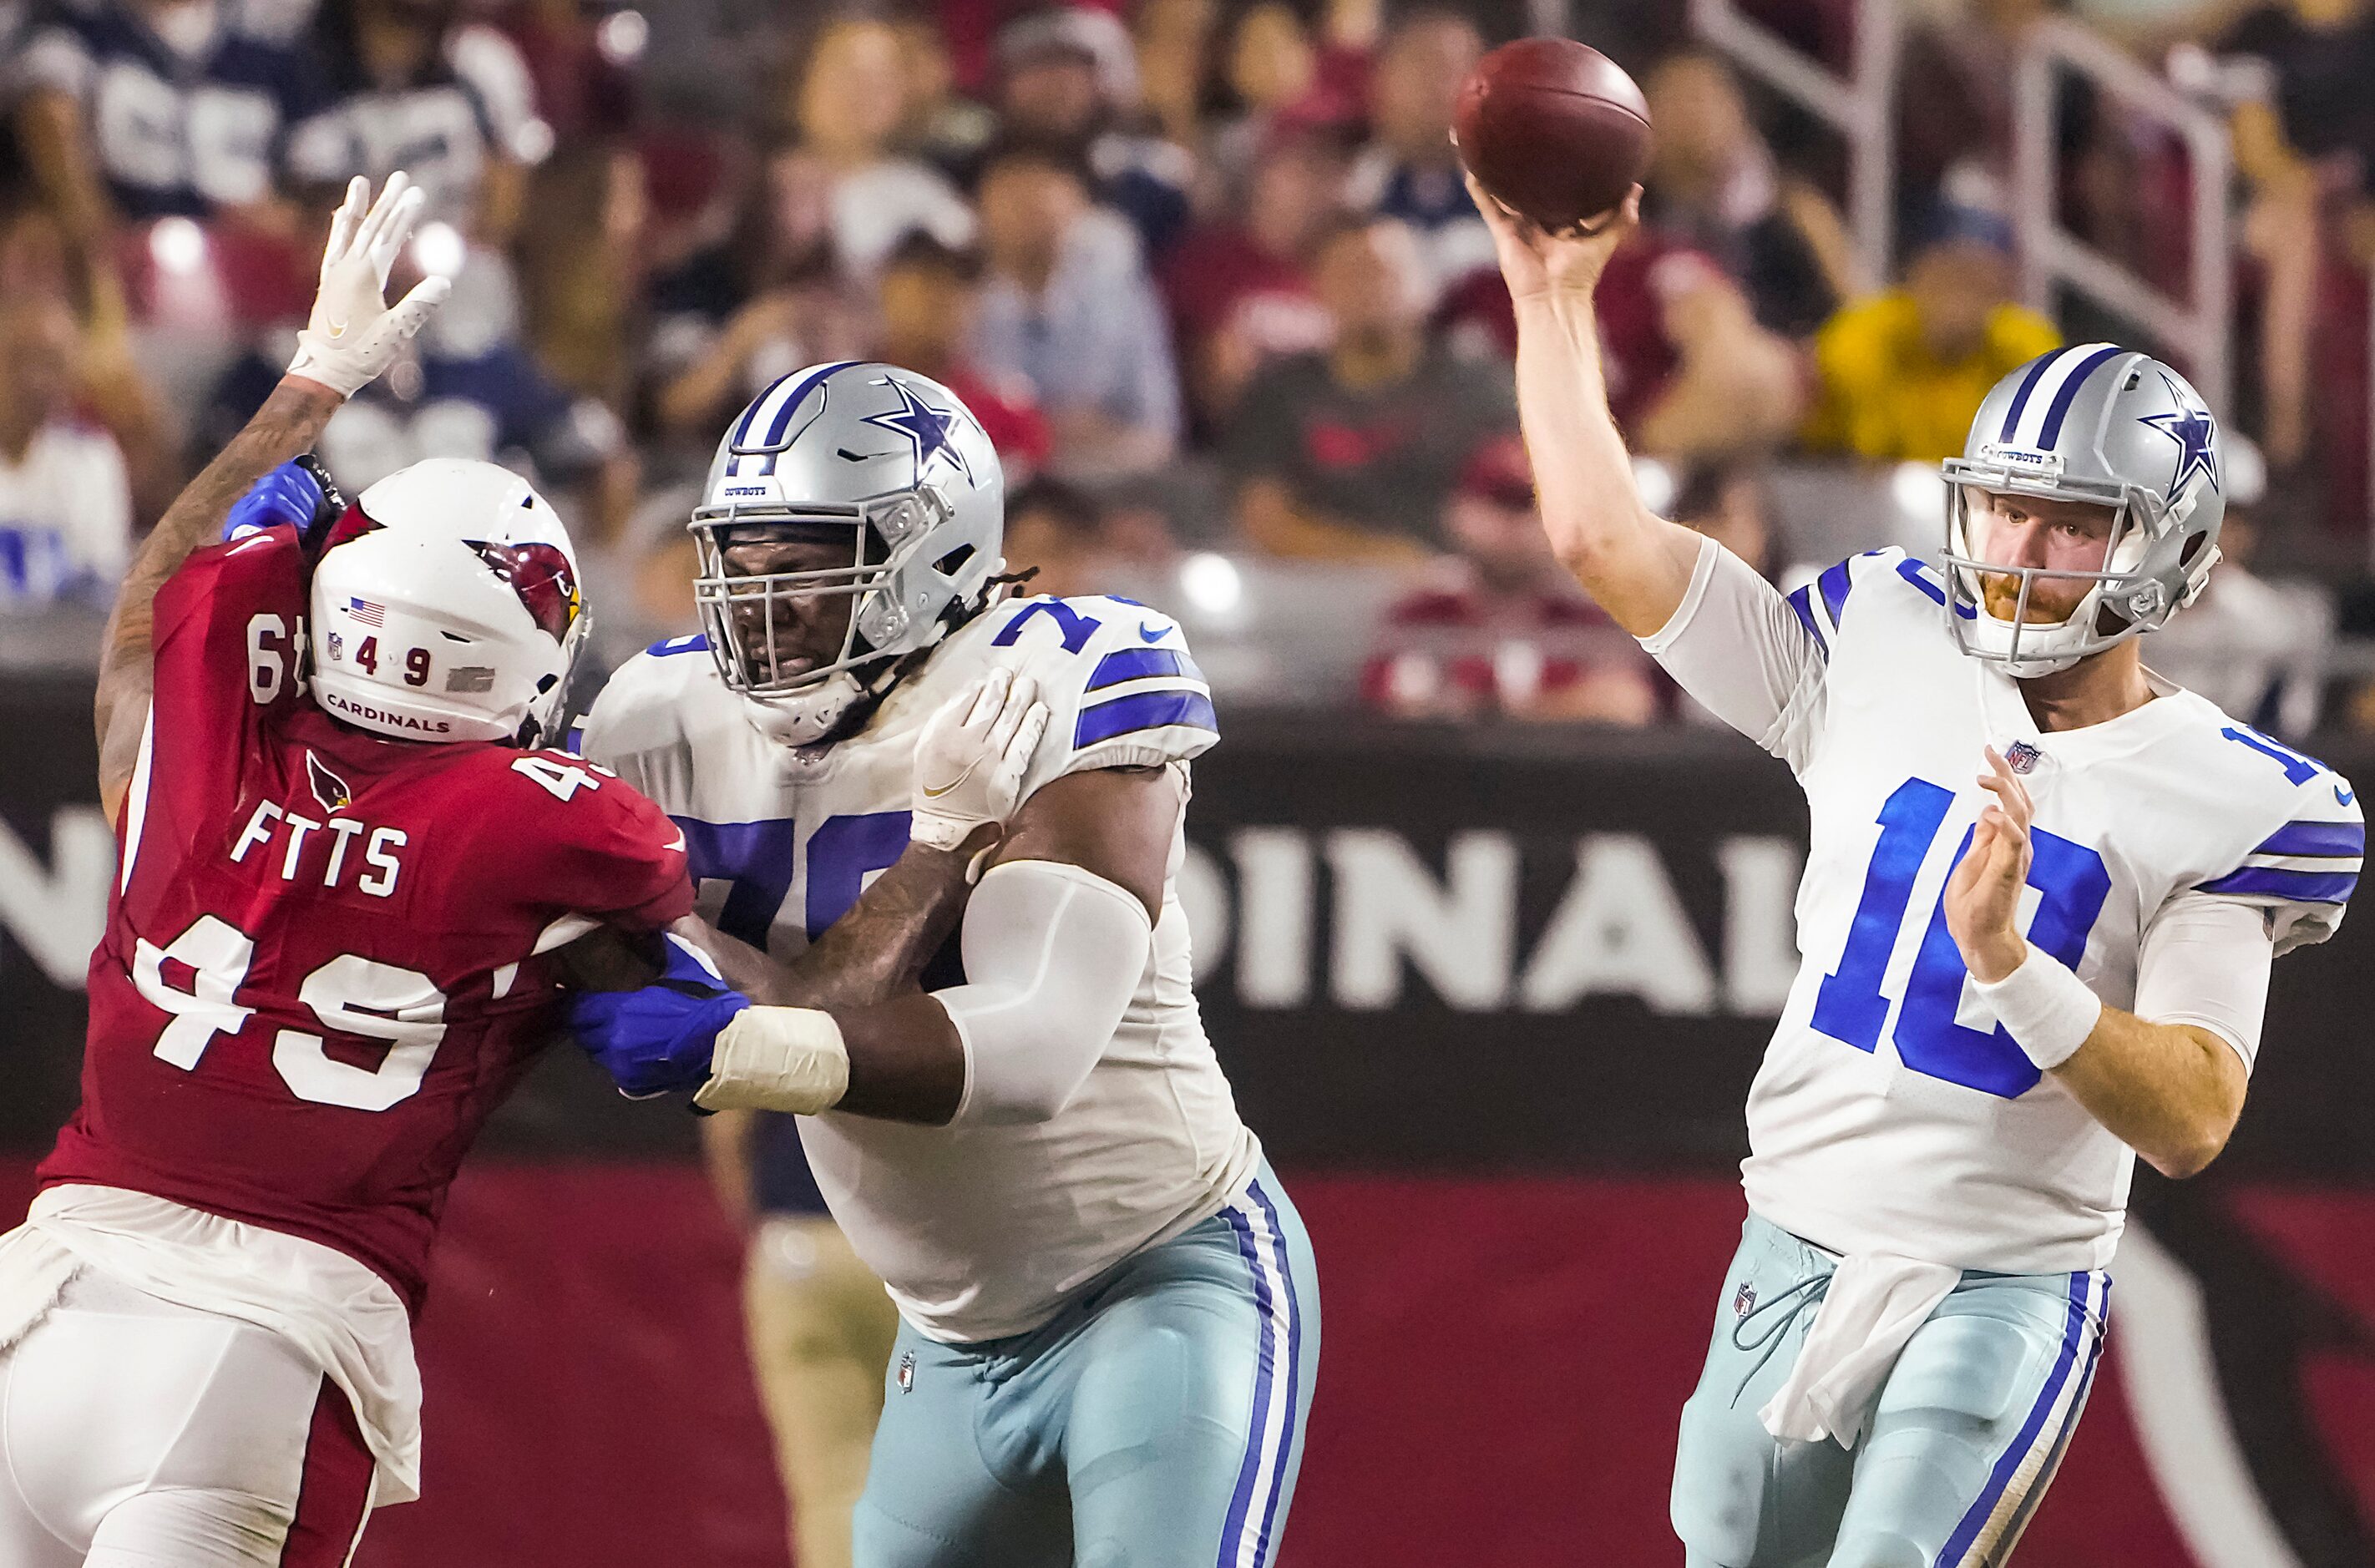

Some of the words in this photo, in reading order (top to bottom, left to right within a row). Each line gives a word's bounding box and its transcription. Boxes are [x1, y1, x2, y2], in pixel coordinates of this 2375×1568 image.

[327, 693, 451, 733] CARDINALS
[132, 913, 448, 1112] 49
[1810, 776, 2112, 1100] 10
